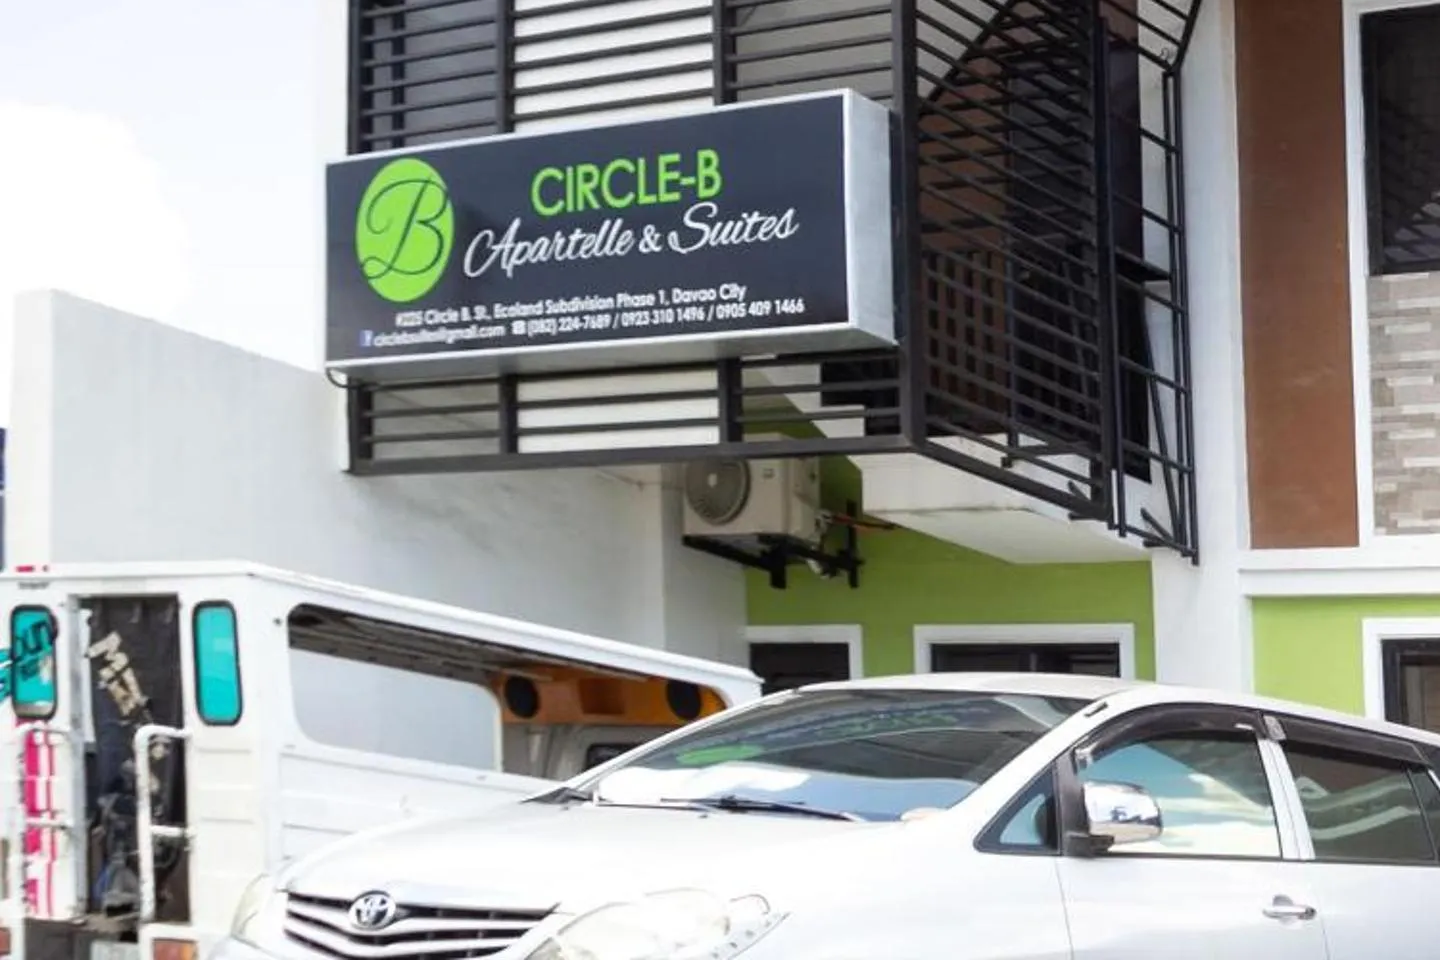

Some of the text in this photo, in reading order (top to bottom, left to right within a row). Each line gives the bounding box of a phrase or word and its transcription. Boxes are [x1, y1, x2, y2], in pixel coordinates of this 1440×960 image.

[531, 148, 723, 217] CIRCLE-B
[361, 176, 449, 280] B
[463, 201, 800, 278] Apartelle & Suites
[493, 301, 544, 319] Ecoland
[545, 294, 614, 314] Subdivision
[616, 292, 655, 308] Phase
[671, 287, 717, 304] Davao
[719, 283, 747, 302] City
[621, 310, 650, 327] 0923
[651, 308, 674, 324] 310
[716, 302, 747, 319] 0905
[774, 298, 805, 314] 1466
